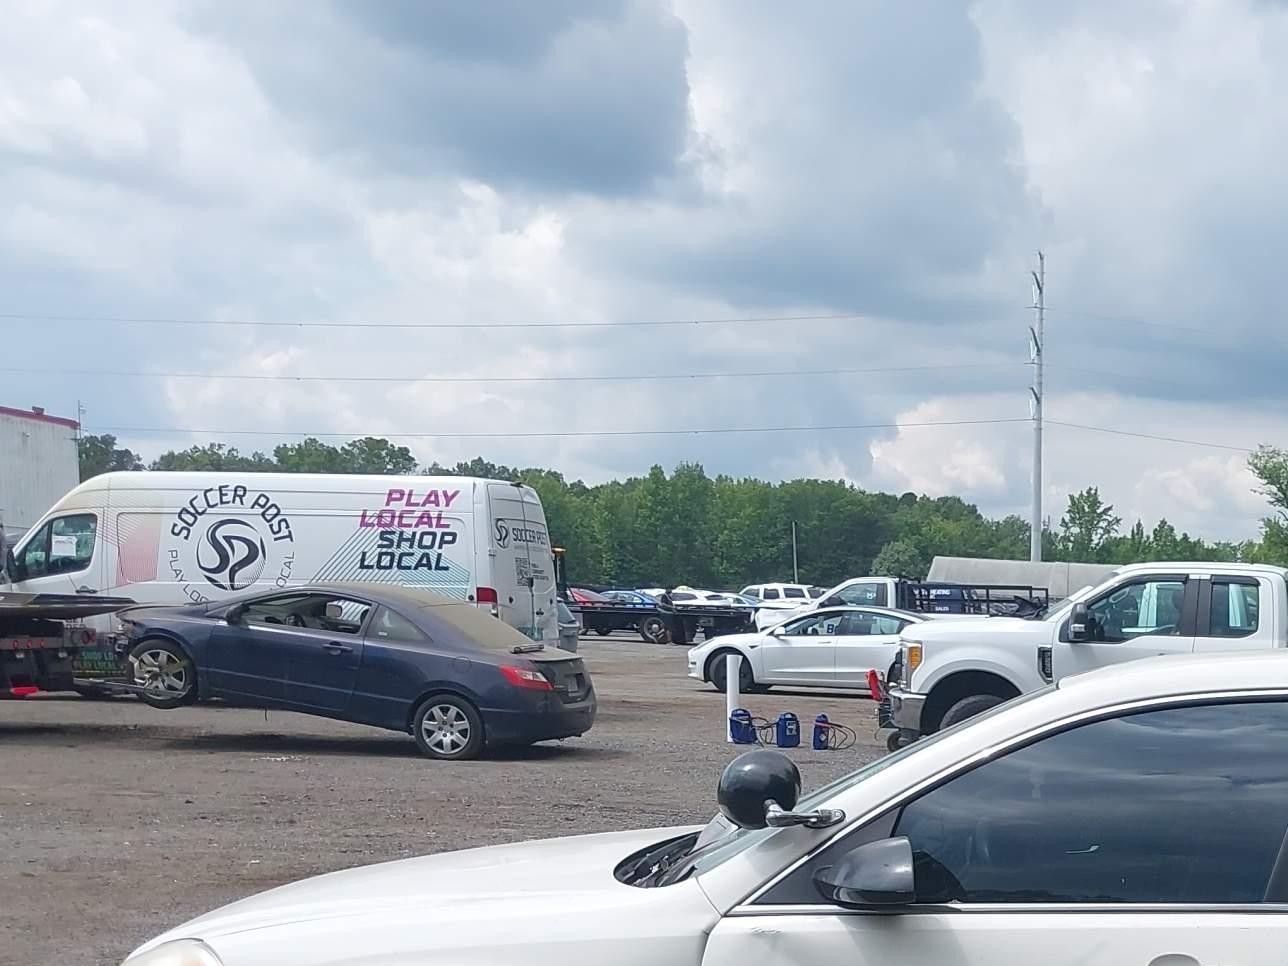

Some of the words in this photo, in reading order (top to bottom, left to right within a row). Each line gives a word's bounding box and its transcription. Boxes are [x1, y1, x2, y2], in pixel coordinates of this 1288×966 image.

[384, 488, 460, 507] PLAY
[171, 485, 247, 540] SOCCER
[250, 493, 294, 543] POST
[359, 509, 451, 528] LOCAL
[376, 530, 458, 549] SHOP
[168, 549, 188, 583] PLAY
[276, 551, 295, 588] OCAL
[359, 551, 450, 571] LOCAL
